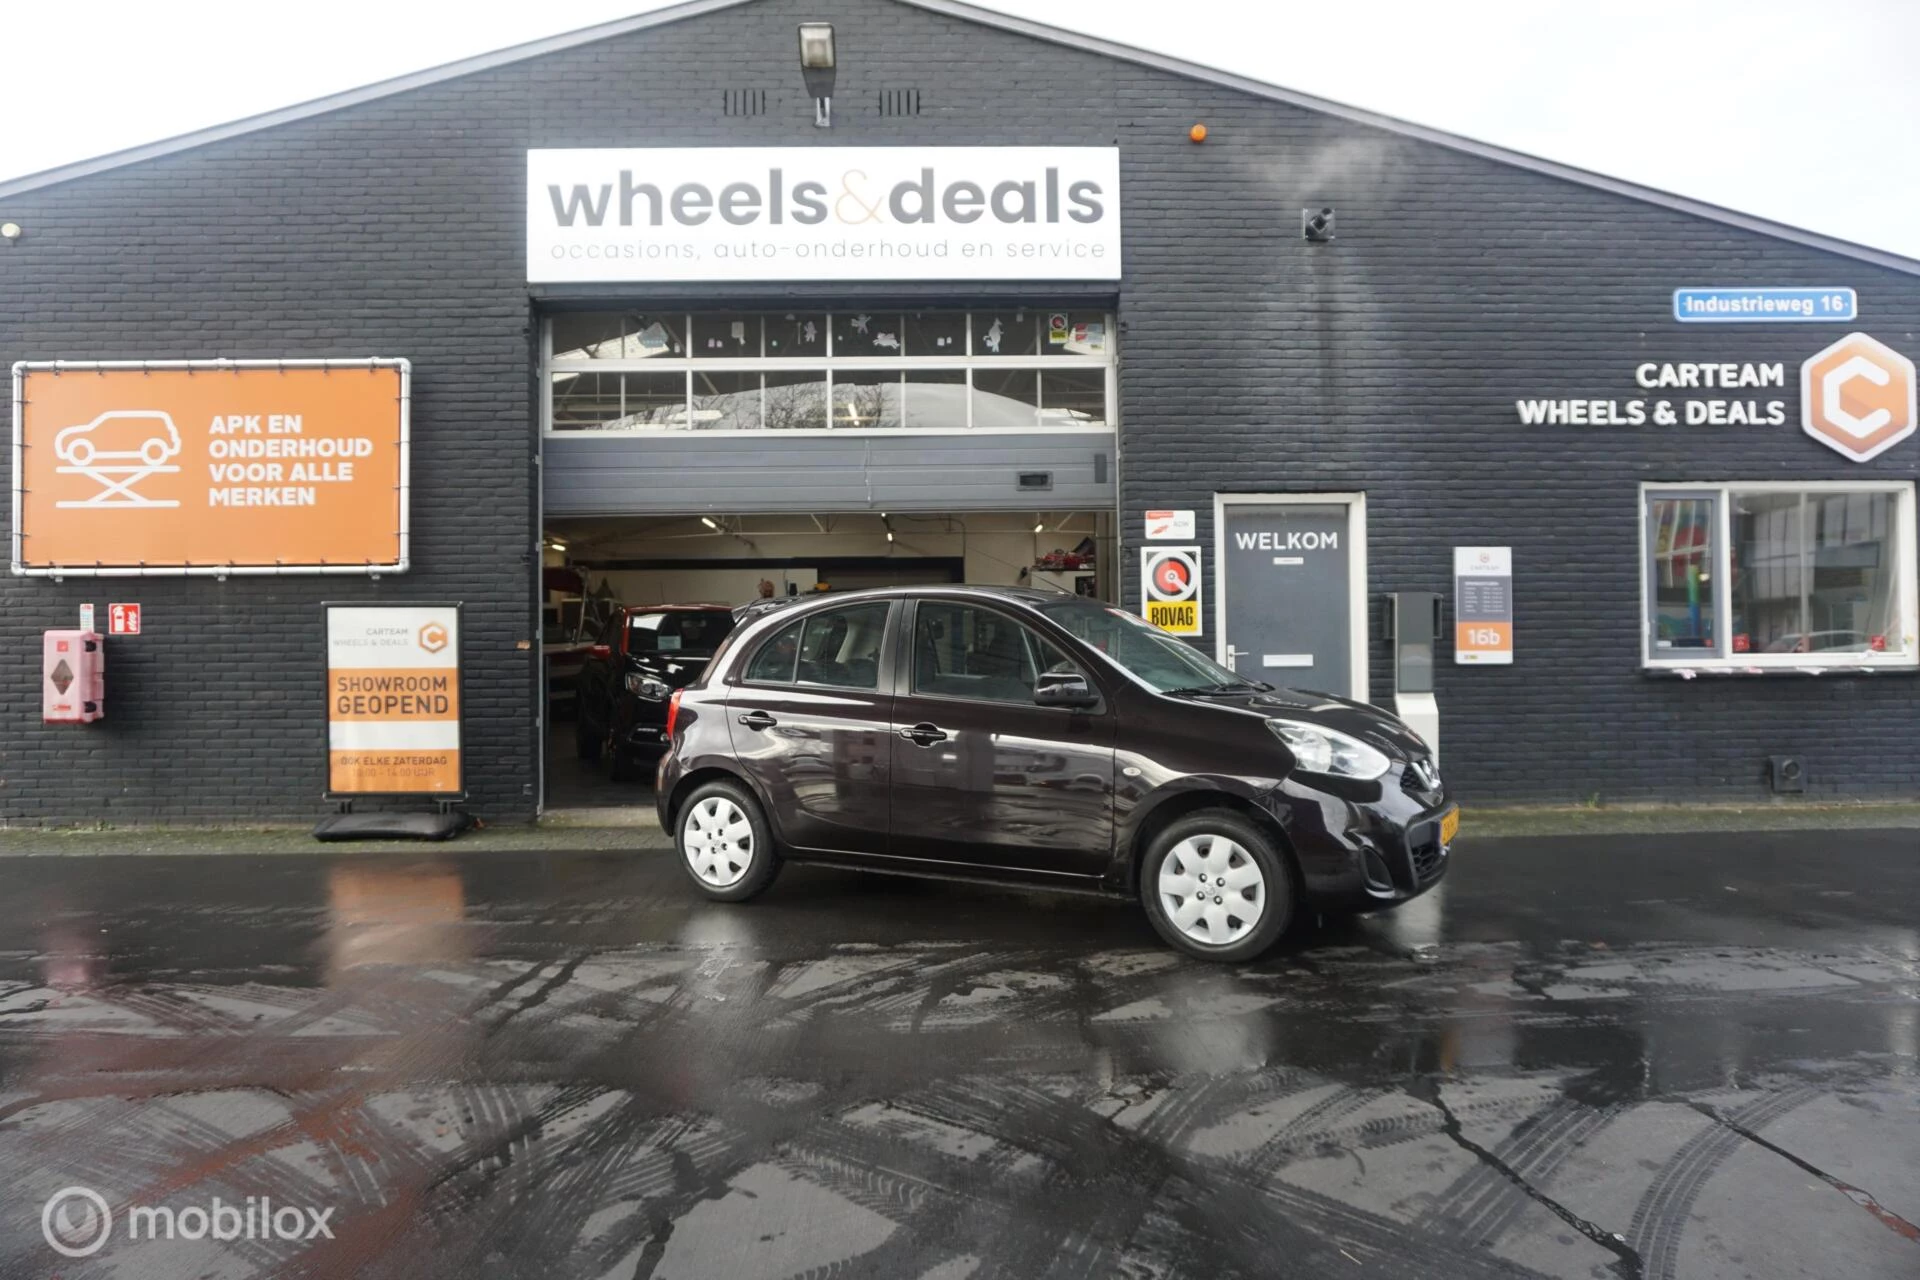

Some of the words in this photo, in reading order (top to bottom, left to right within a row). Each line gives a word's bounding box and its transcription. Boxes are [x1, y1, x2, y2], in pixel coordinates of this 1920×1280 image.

[550, 239, 701, 260] occasions,
[713, 238, 948, 259] auto-onderhoud
[961, 242, 993, 258] en
[1006, 238, 1105, 258] service
[1686, 295, 1814, 316] Industrieweg
[1821, 295, 1843, 312] 16
[1635, 363, 1784, 388] CARTEAM
[1516, 399, 1646, 426] WHEELS
[1652, 400, 1677, 425] &
[1685, 400, 1785, 425] DEALS
[208, 415, 262, 434] APK
[268, 414, 302, 434] EN
[208, 437, 373, 458] ONDERHOUD
[208, 463, 283, 482] VOOR
[289, 462, 354, 481] ALLE
[208, 487, 316, 506] MERKEN
[1235, 531, 1338, 550] WELKOM
[1151, 606, 1194, 627] BOVAG
[366, 627, 409, 636] CARTEAM
[1467, 628, 1501, 646] 16b
[380, 638, 409, 647] DEALS
[337, 676, 448, 692] SHOWROOM
[337, 695, 449, 715] GEOPEND
[363, 756, 390, 766] ELKE
[393, 756, 448, 766] ZATERDAG
